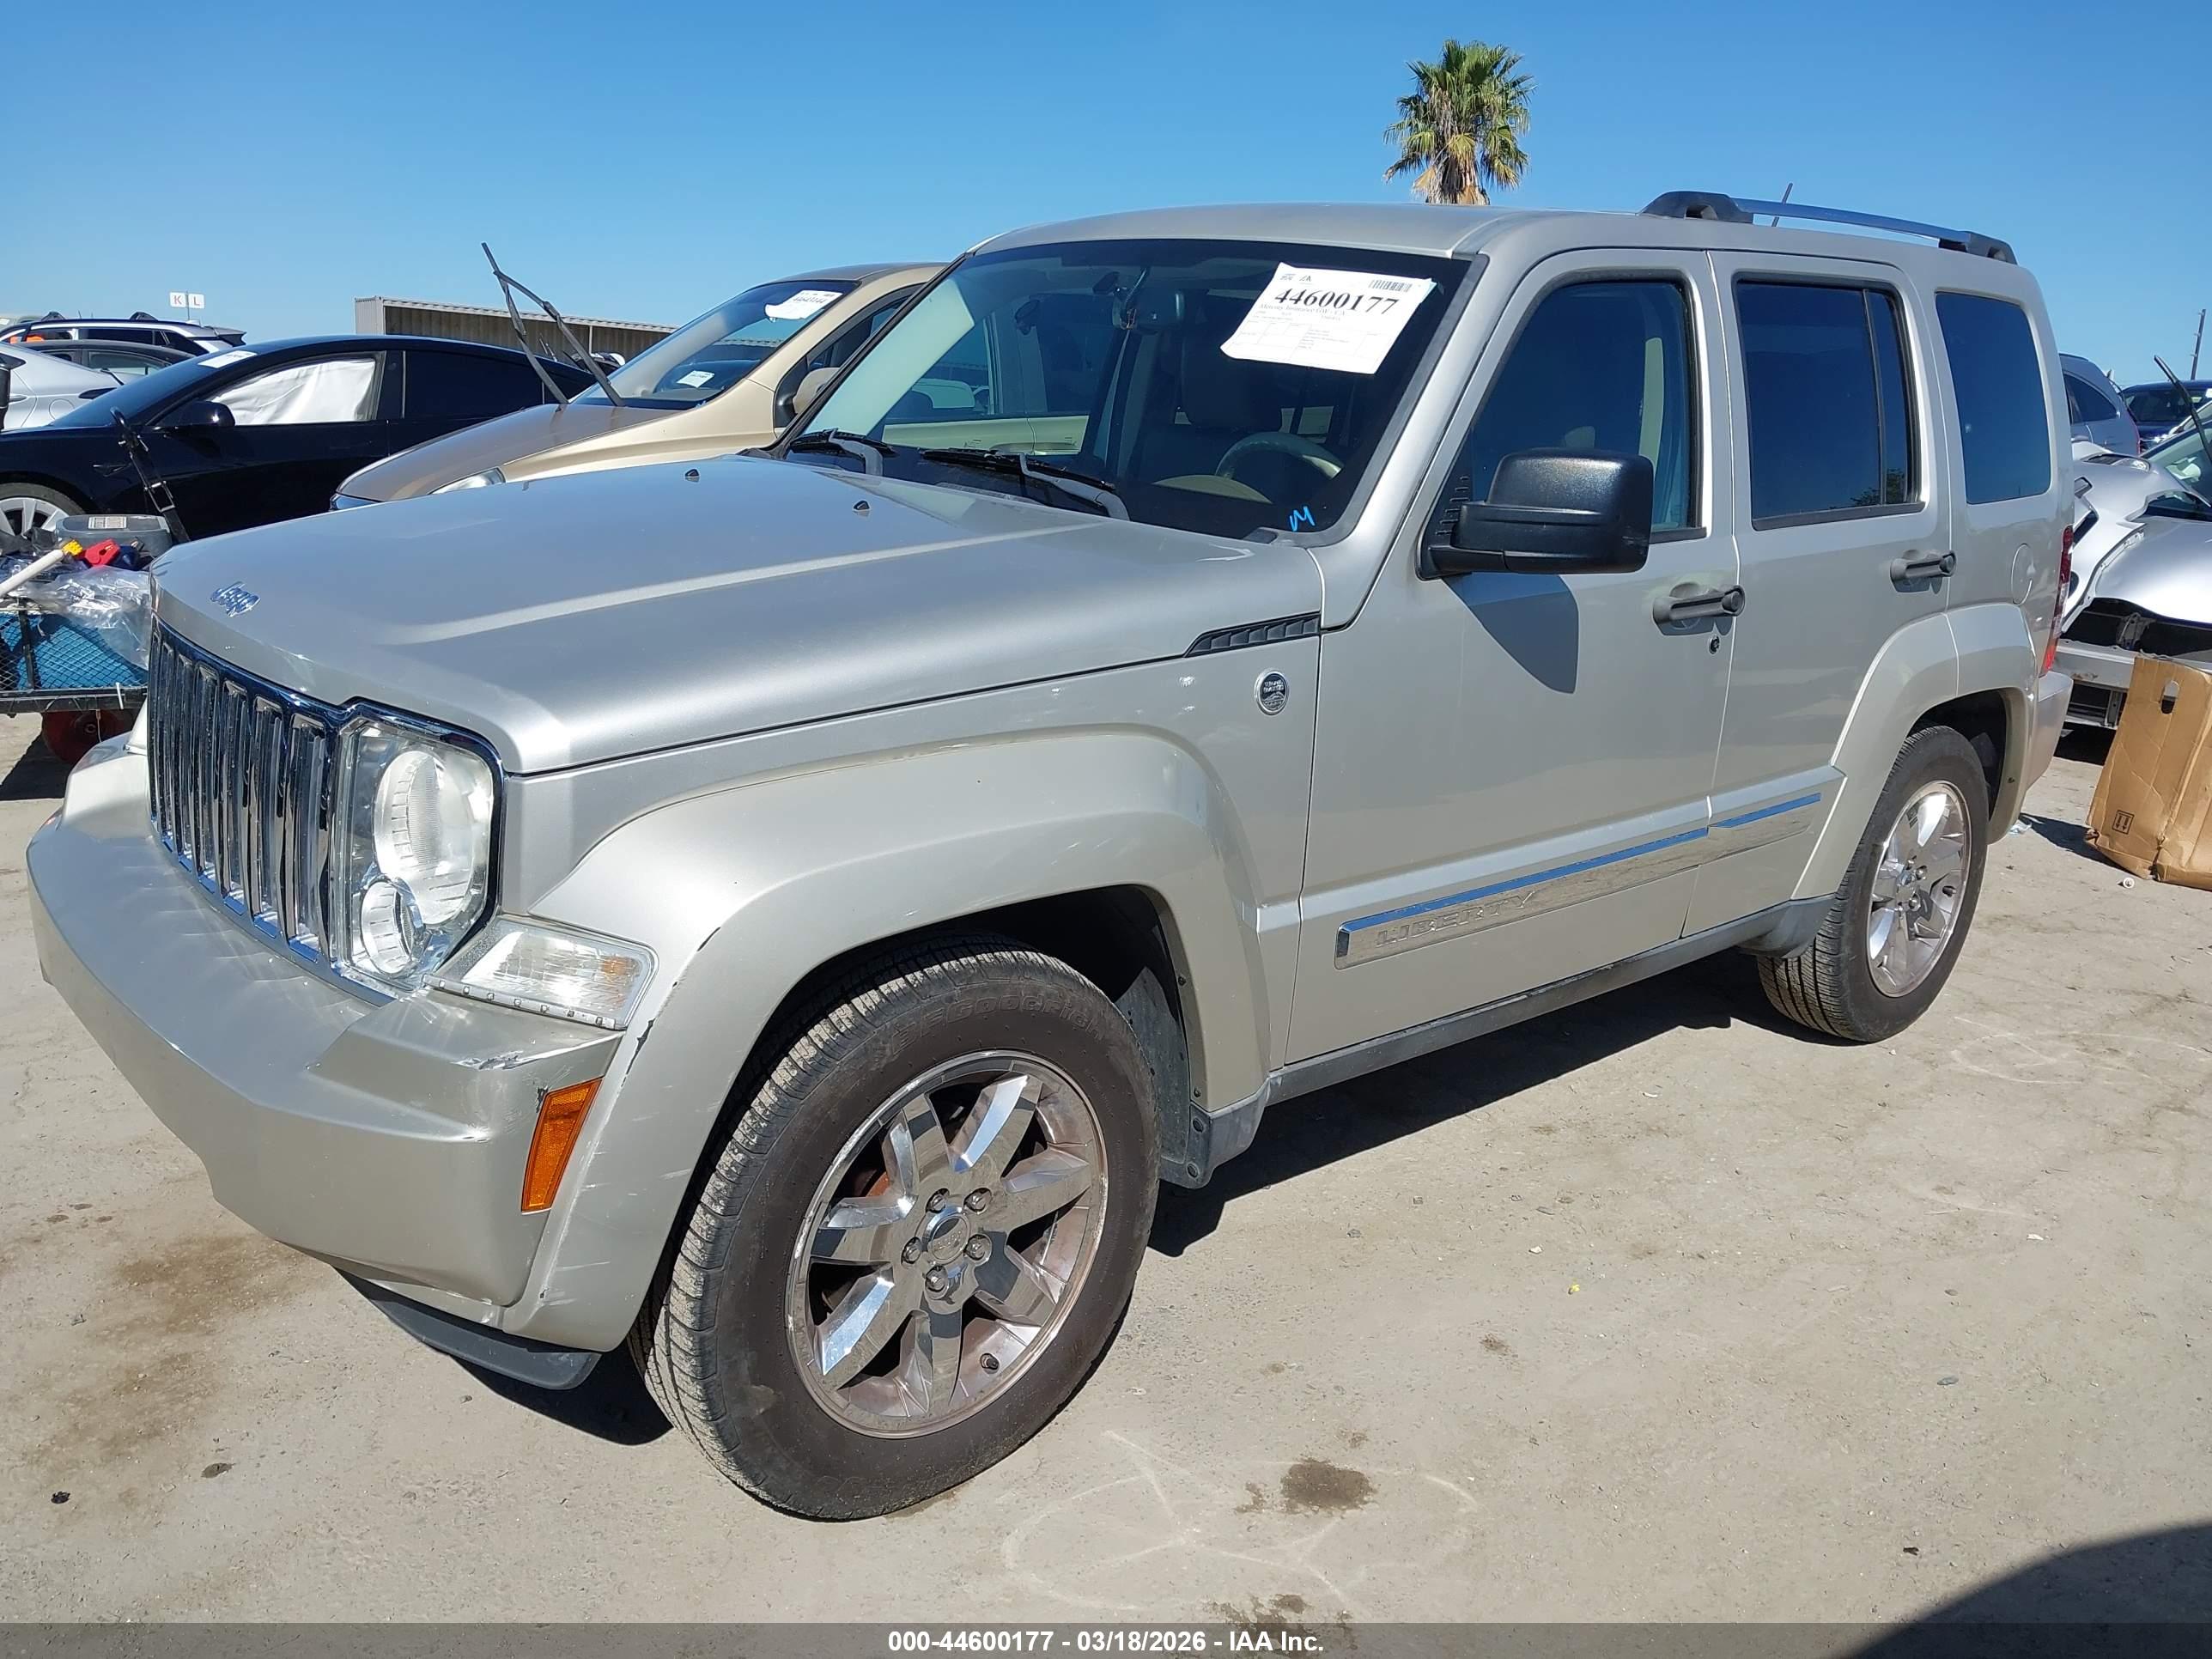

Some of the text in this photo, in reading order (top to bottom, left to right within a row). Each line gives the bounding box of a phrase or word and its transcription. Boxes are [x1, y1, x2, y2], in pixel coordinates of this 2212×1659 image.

[174, 295, 183, 305] K
[193, 295, 201, 307] L
[1274, 288, 1400, 315] 44600177
[1376, 890, 1537, 948] LIBERTY
